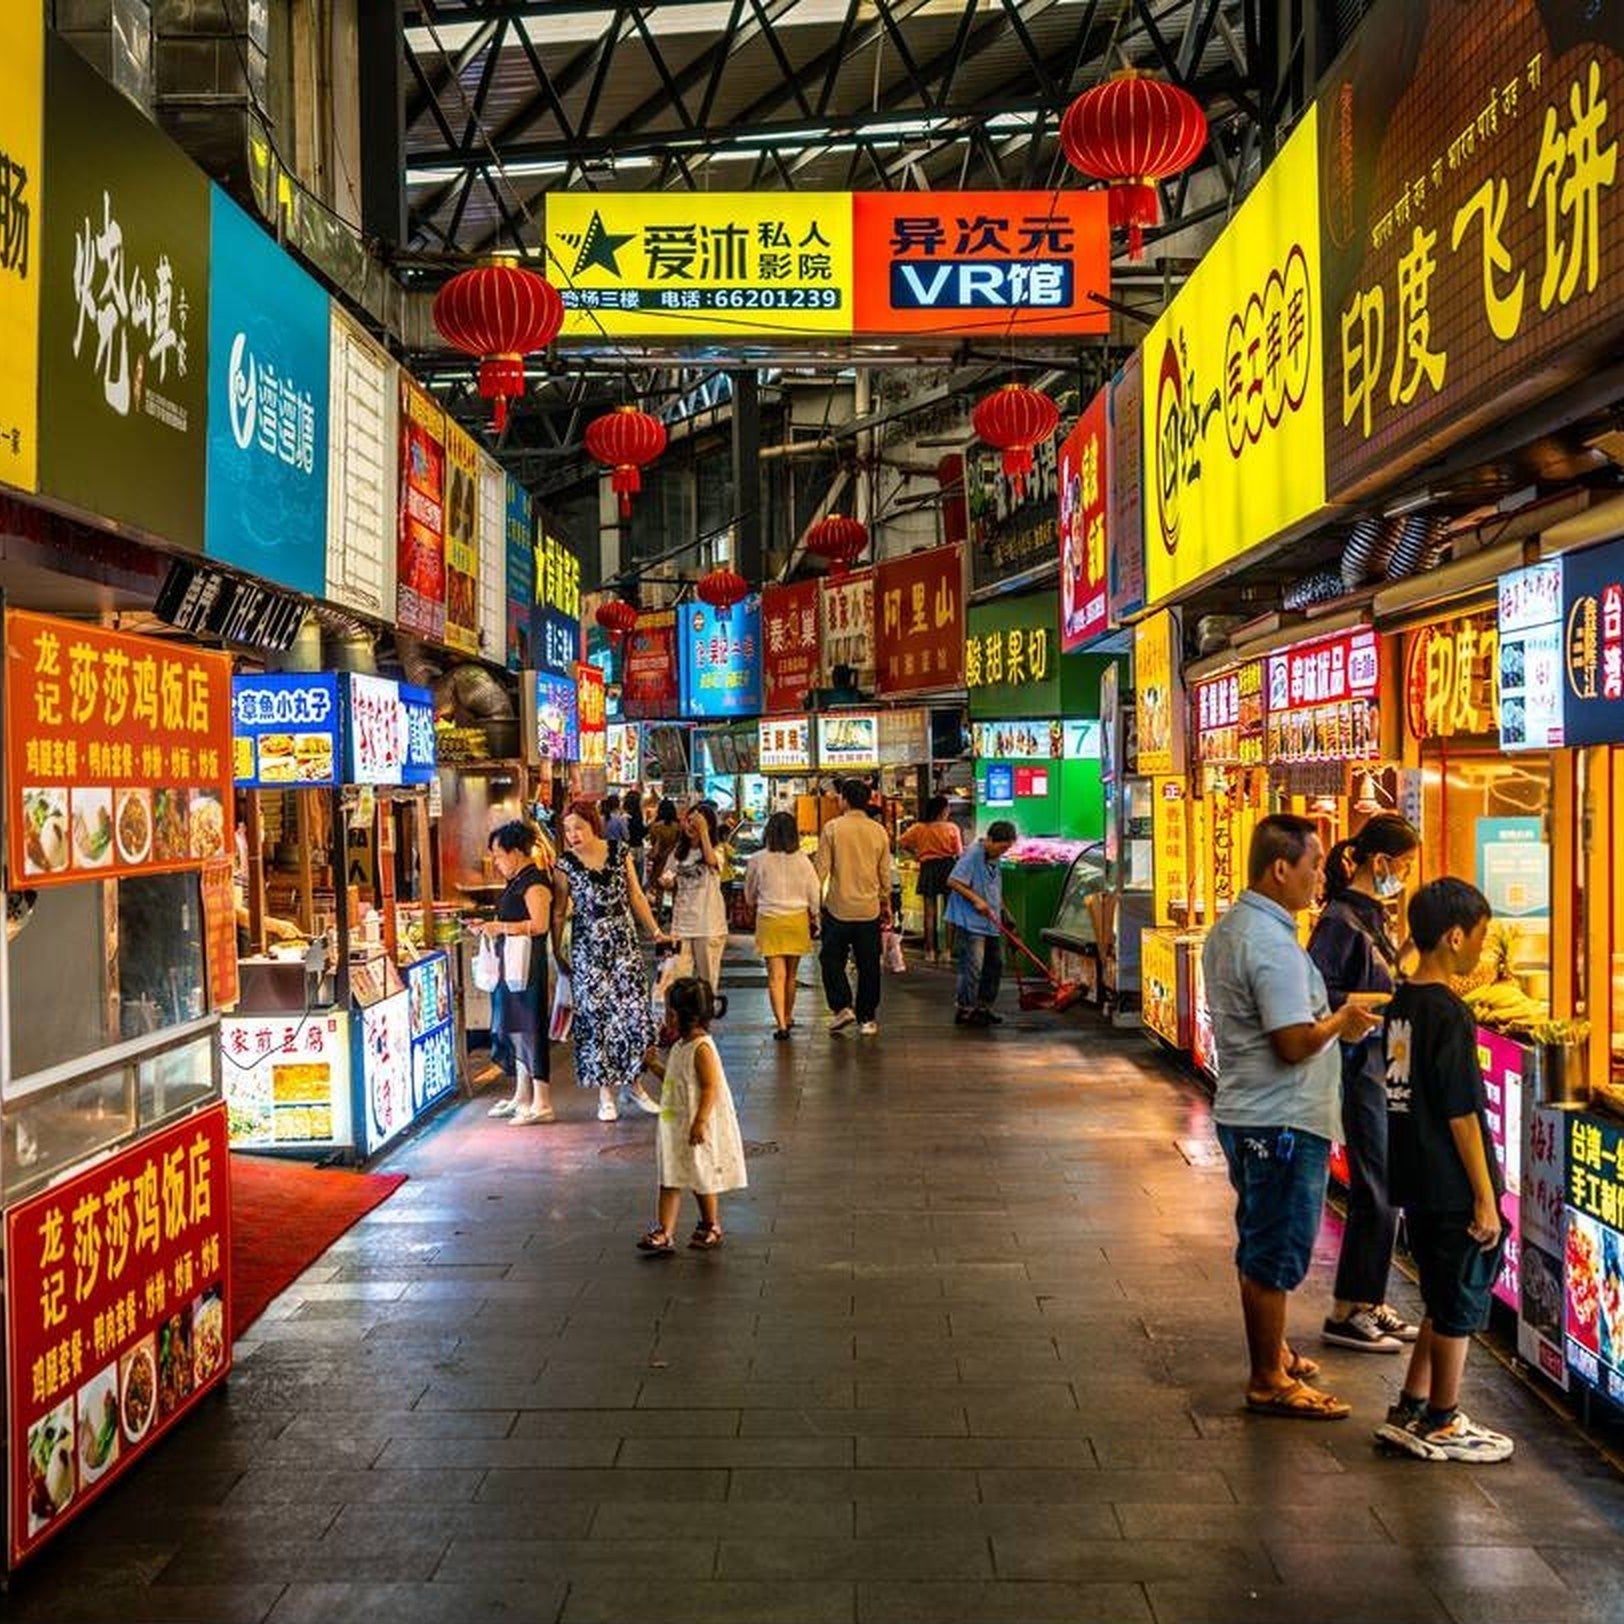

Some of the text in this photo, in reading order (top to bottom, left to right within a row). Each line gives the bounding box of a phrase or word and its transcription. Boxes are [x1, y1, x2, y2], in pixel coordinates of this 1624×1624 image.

[643, 221, 750, 280] 爱沐
[758, 221, 831, 249] 私人
[889, 215, 1075, 256] 异次元
[1341, 59, 1618, 439] 印度飞饼
[758, 253, 833, 281] 影院
[900, 262, 1065, 305] VR馆
[219, 582, 263, 641] THE
[883, 575, 955, 641] 阿里山
[33, 629, 63, 726] 龙记
[964, 627, 1048, 687] 酸甜果切
[68, 641, 210, 734] 莎莎鸡饭店
[233, 689, 330, 723] 章魚小丸子
[1070, 725, 1092, 755] 7
[220, 1024, 324, 1055] 家煎豆腐
[71, 1130, 211, 1304] 莎莎鸡饭店
[39, 1204, 67, 1331] 龙记
